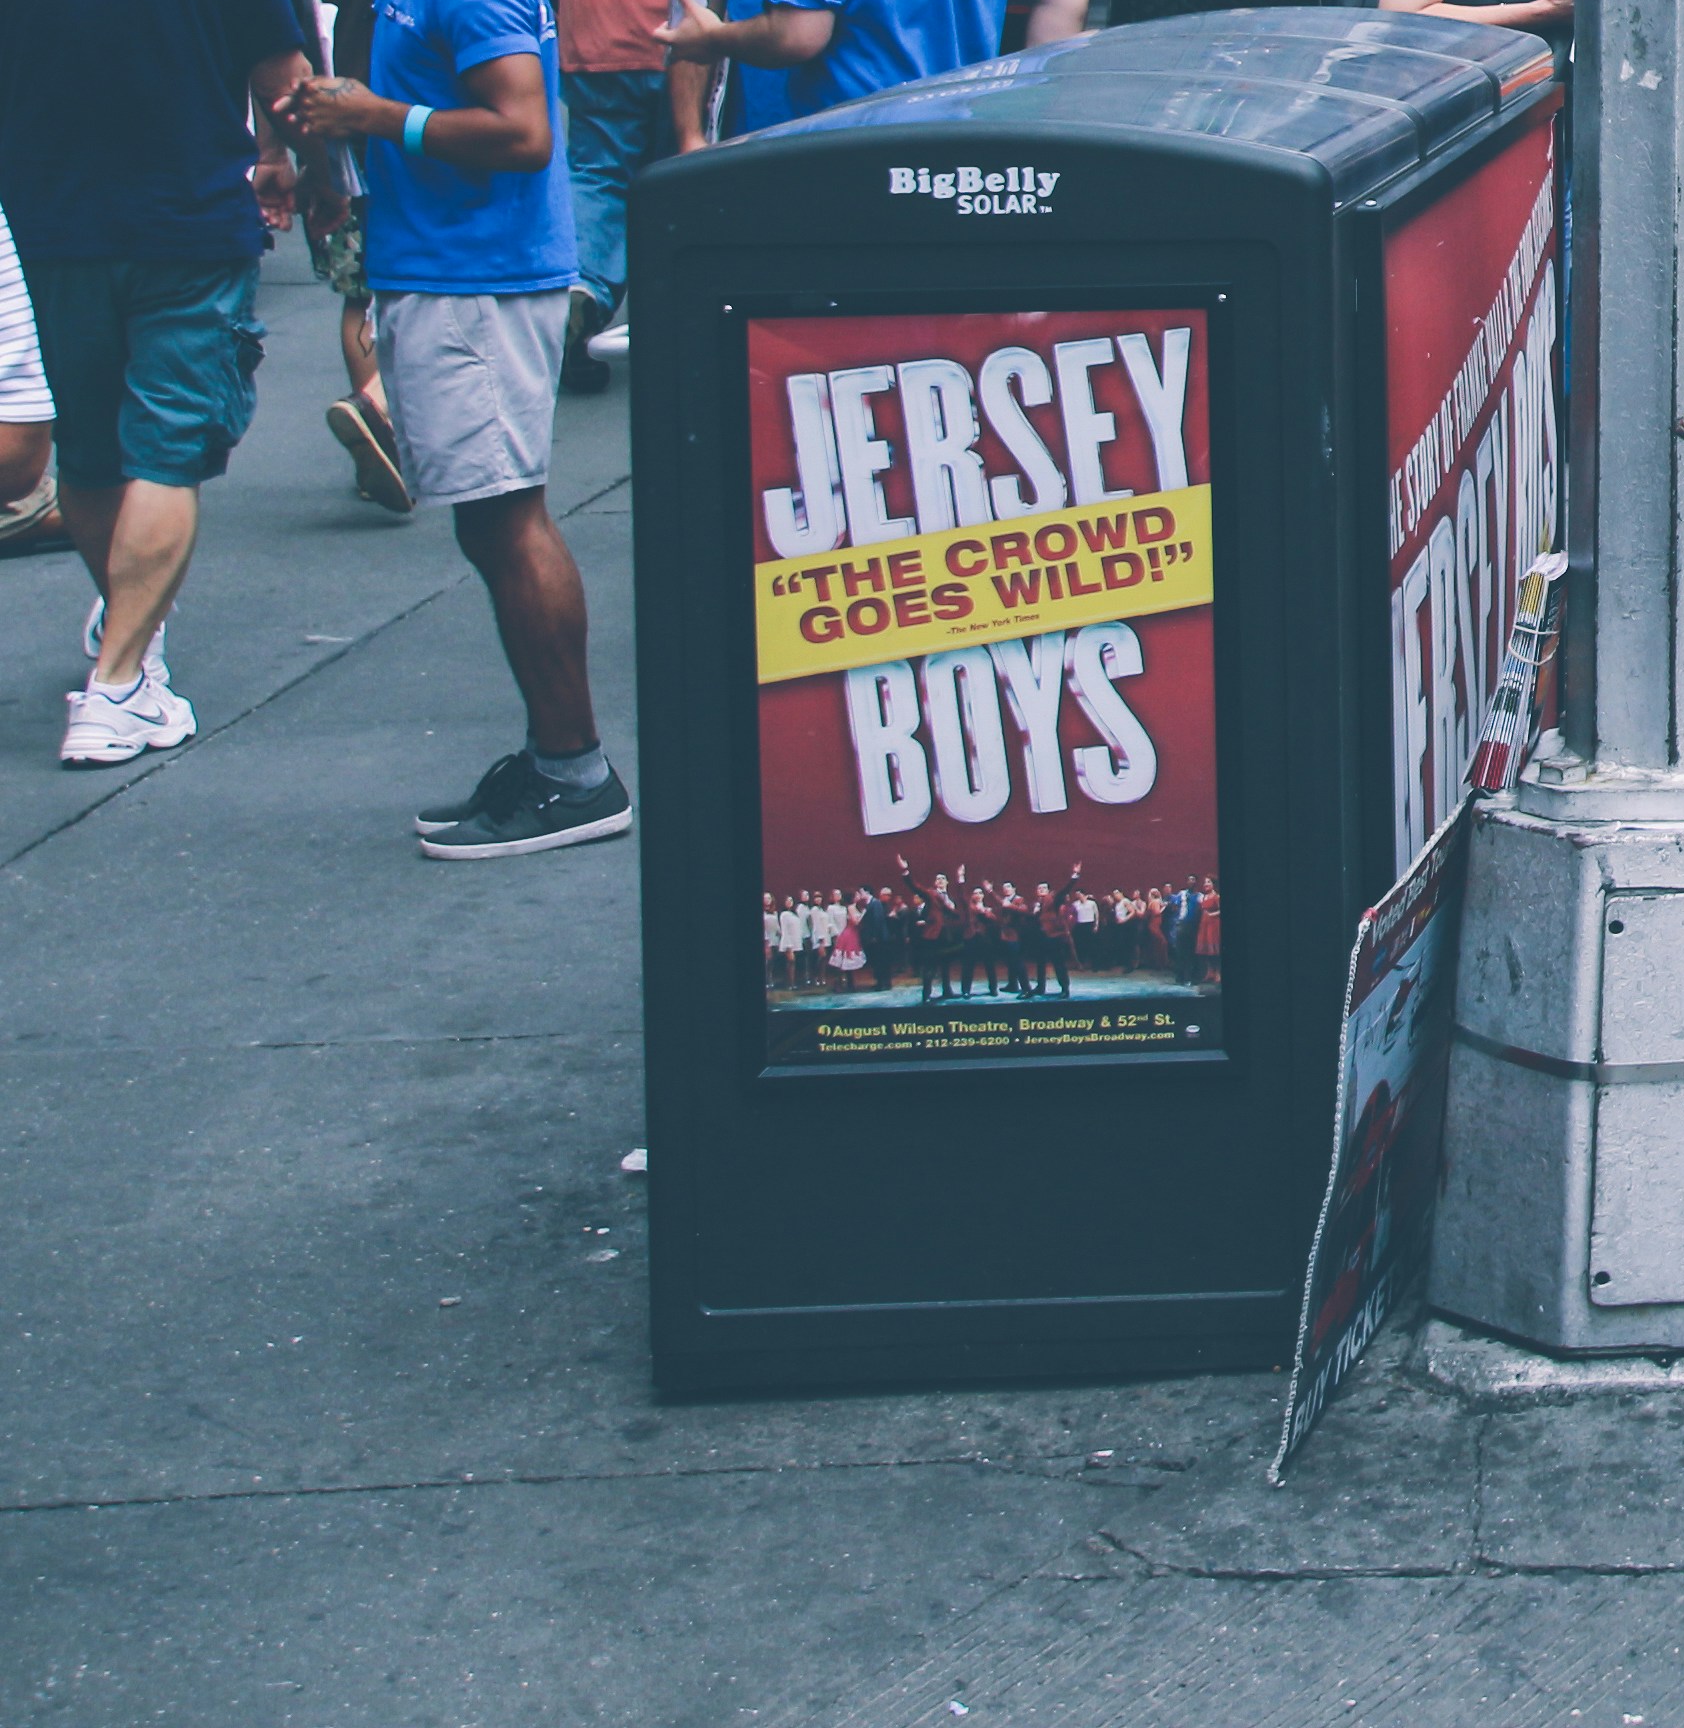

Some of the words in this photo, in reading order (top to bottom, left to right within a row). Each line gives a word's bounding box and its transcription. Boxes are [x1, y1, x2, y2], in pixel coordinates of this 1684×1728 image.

[888, 166, 1061, 199] BigBelly
[956, 194, 1038, 216] SOLAR
[760, 325, 1194, 561] JERSEY
[1406, 411, 1442, 536] STORY
[1441, 388, 1455, 475] OF
[1453, 328, 1489, 453] FRANKIE
[1485, 289, 1508, 387] VALLI
[942, 501, 1179, 590] CROWD
[798, 583, 977, 646] GOES
[845, 619, 1160, 838] BOYS
[818, 1040, 913, 1053] Telecharge.com
[925, 1036, 1010, 1049] 212-239-6200
[1023, 1030, 1176, 1045] JerseyBoysBroadway.com
[831, 1023, 888, 1039] August
[892, 1021, 945, 1035] Wilson
[949, 1019, 1014, 1034] Theatre,
[1019, 1016, 1095, 1033] Broadway
[1100, 1016, 1112, 1029] &
[1116, 1013, 1149, 1028] 52nd
[1154, 1013, 1176, 1027] St.
